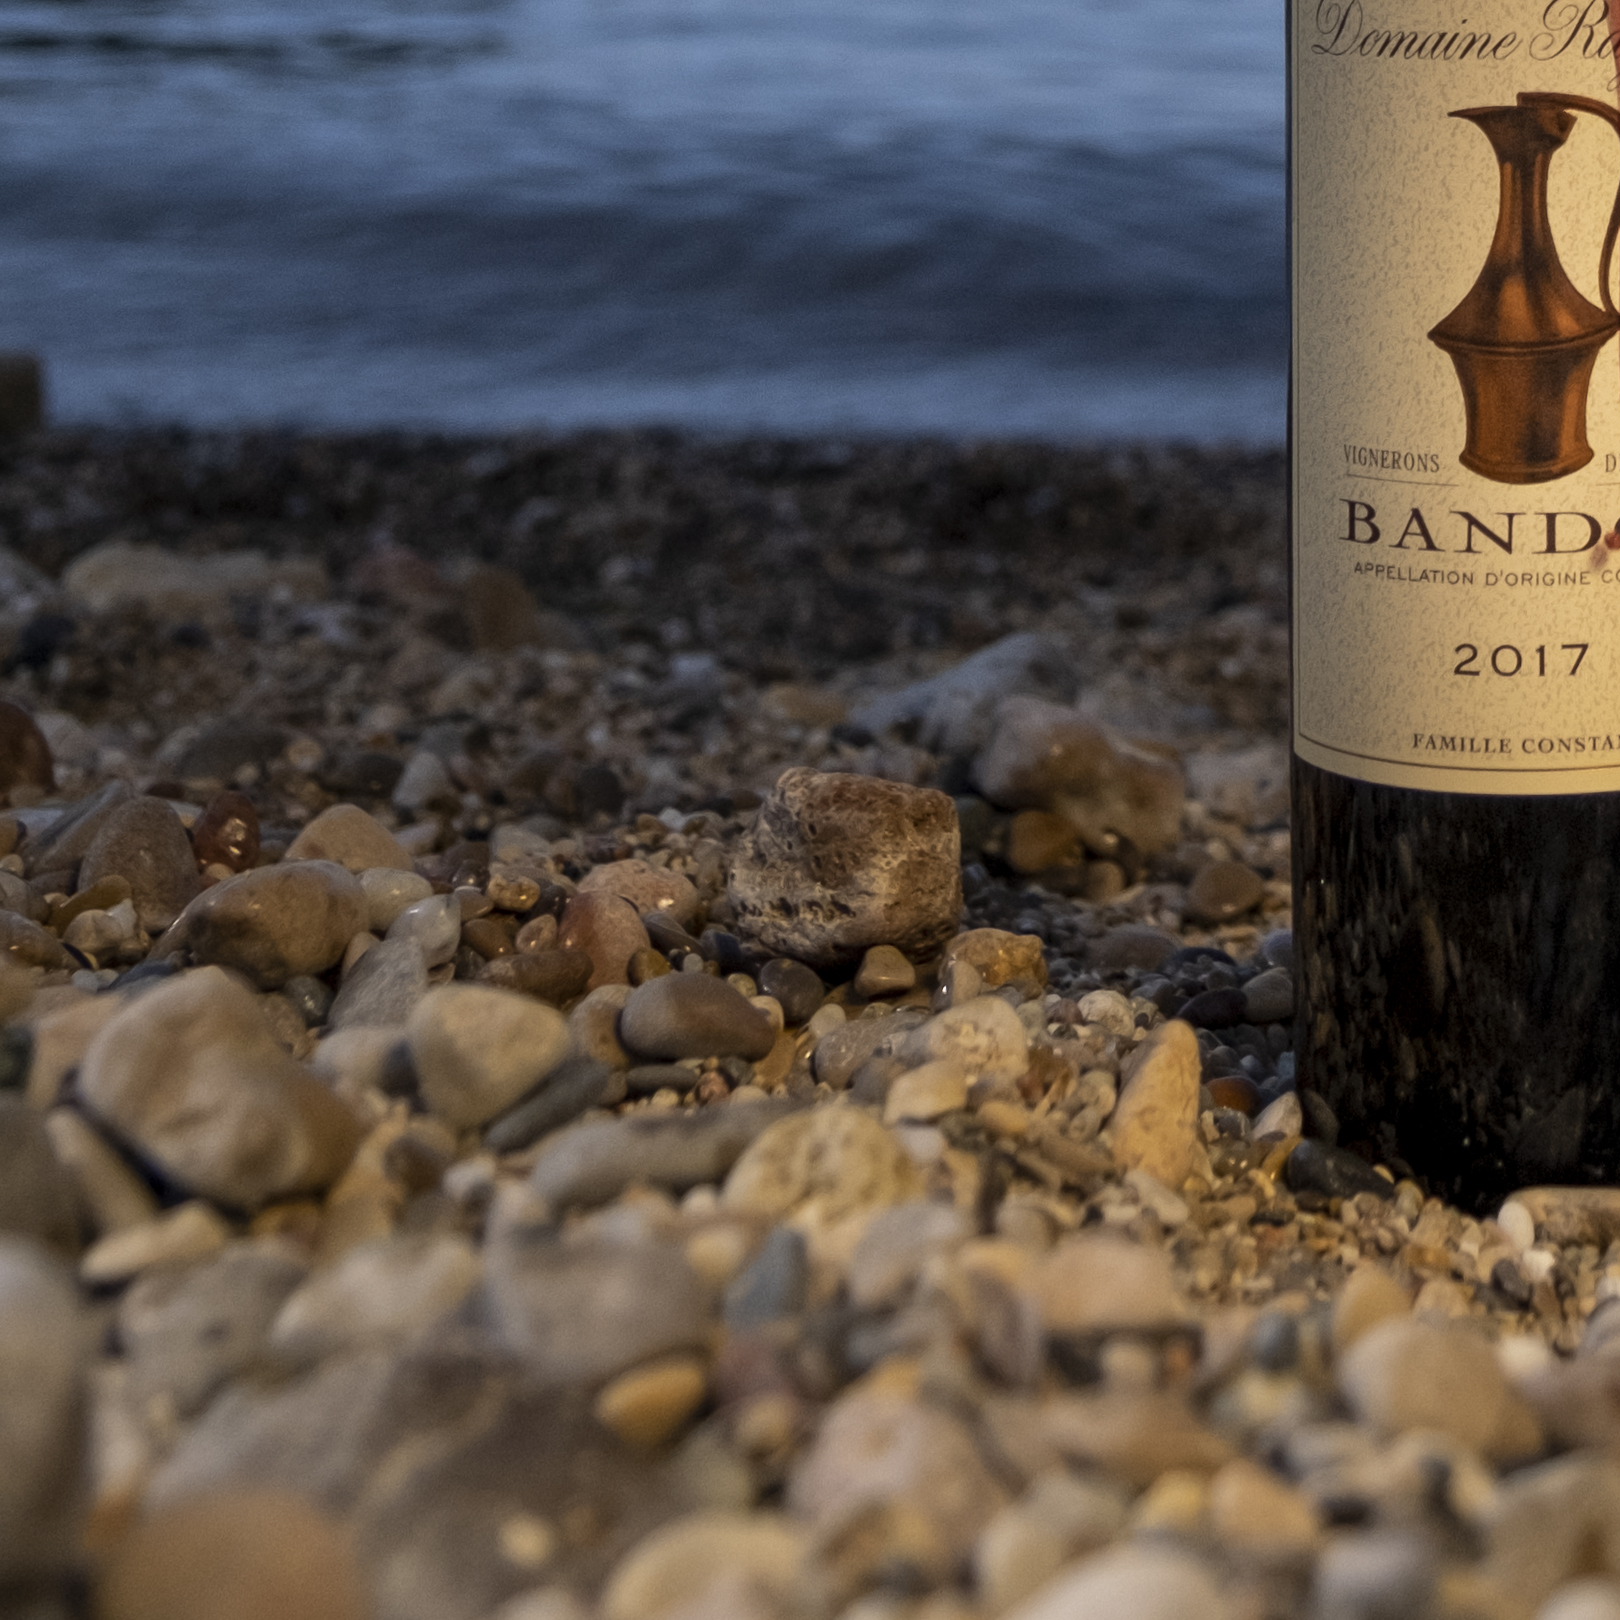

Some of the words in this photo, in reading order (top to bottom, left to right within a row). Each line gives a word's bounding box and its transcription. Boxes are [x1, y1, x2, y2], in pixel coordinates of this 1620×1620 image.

[1343, 444, 1441, 473] VIGNERONS
[1353, 561, 1475, 586] APPELLATION
[1485, 571, 1592, 587] D'ORIGINE
[1453, 643, 1590, 677] 2017
[1412, 733, 1512, 755] FAMILLE
